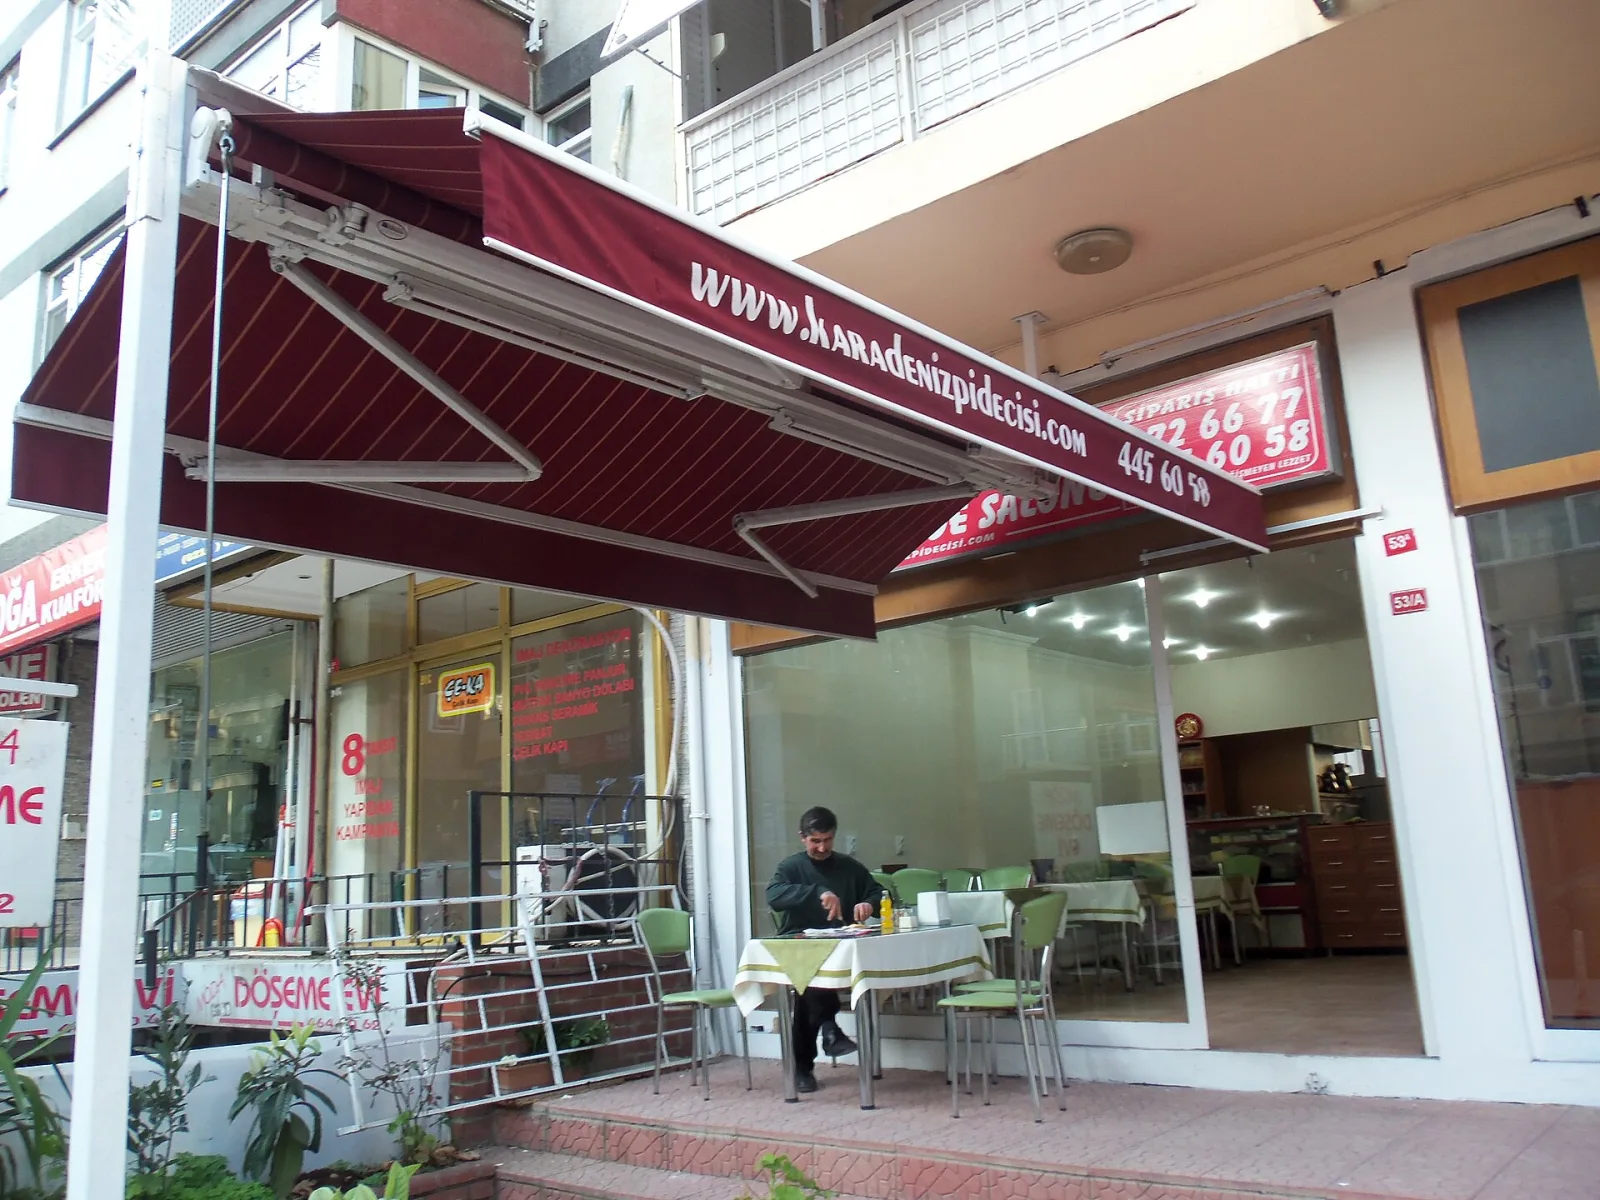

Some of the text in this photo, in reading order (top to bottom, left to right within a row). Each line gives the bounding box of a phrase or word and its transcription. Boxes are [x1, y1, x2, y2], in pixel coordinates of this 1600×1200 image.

[1200, 403, 1244, 439] 66
[1257, 386, 1304, 425] 77
[1206, 418, 1311, 470] 60 58
[1117, 441, 1154, 484] 445
[1160, 459, 1185, 497] 60
[1187, 471, 1211, 508] 58
[341, 732, 365, 777] 8
[234, 968, 331, 1020] DÖŞEME
